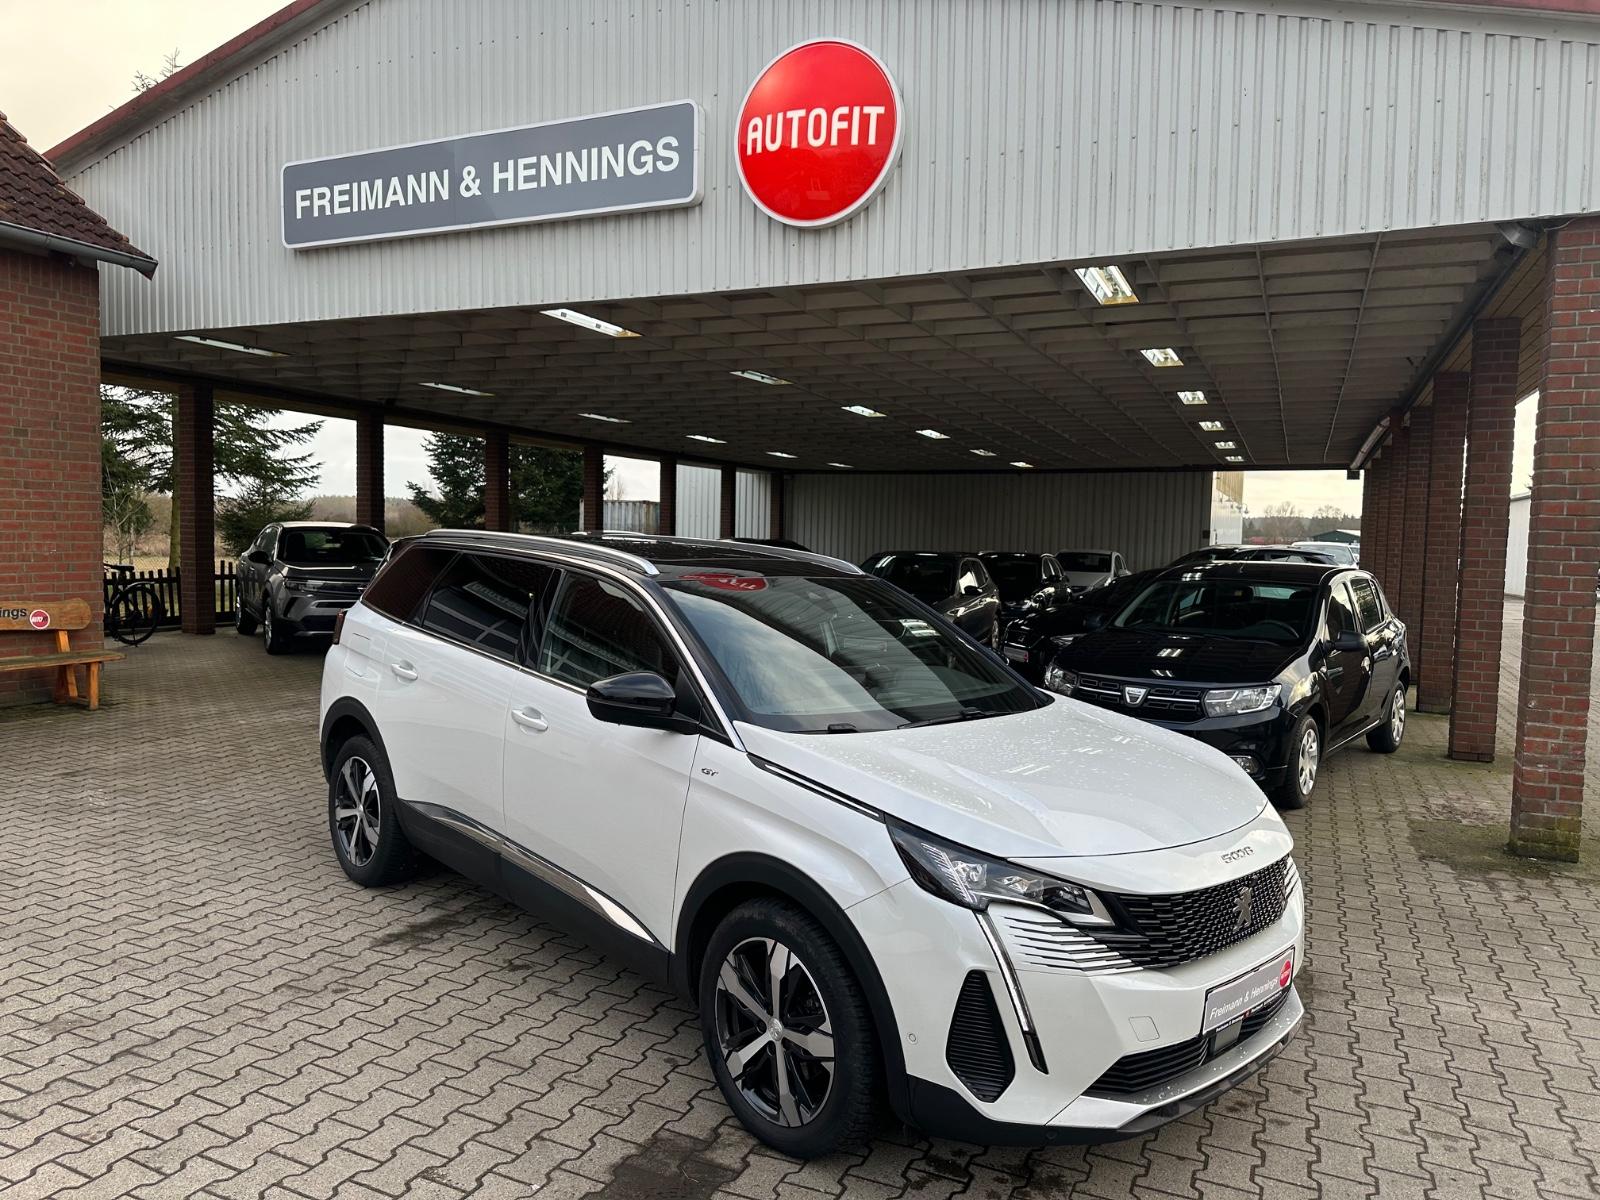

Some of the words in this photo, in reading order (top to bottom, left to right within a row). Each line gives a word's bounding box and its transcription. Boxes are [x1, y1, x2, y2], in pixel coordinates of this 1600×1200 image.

[747, 106, 885, 156] AUTOFIT
[295, 169, 449, 219] FREIMANN
[459, 165, 481, 198] &
[492, 136, 680, 193] HENNINGS
[1209, 997, 1243, 1020] Freimann
[1244, 992, 1250, 1002] &
[1250, 976, 1280, 999] Hennings
